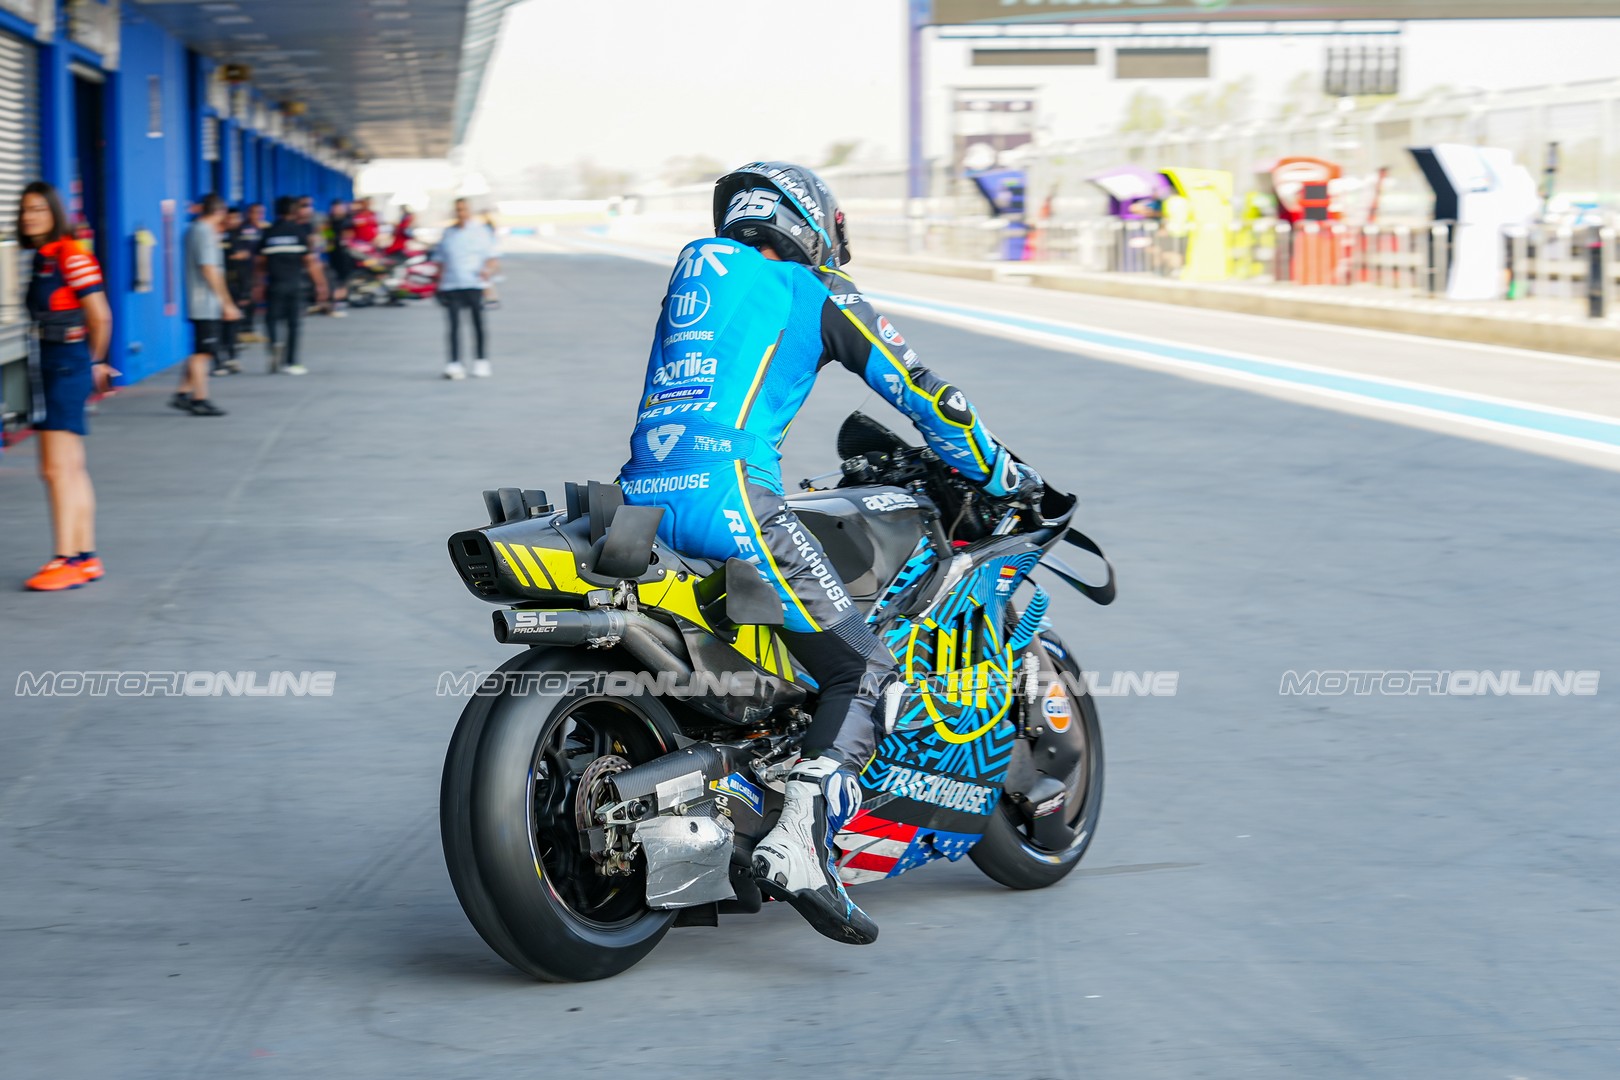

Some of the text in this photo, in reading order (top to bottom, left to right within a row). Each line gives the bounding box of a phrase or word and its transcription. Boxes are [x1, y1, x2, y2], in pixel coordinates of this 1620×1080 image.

[724, 190, 780, 225] 25
[768, 168, 826, 221] SHARK
[653, 352, 718, 386] aprilia
[660, 388, 705, 400] MICHELIN
[513, 626, 557, 634] PROJECT
[515, 611, 559, 628] SC
[729, 779, 760, 805] MICHELIN
[880, 764, 993, 815] TRACKHOUSE
